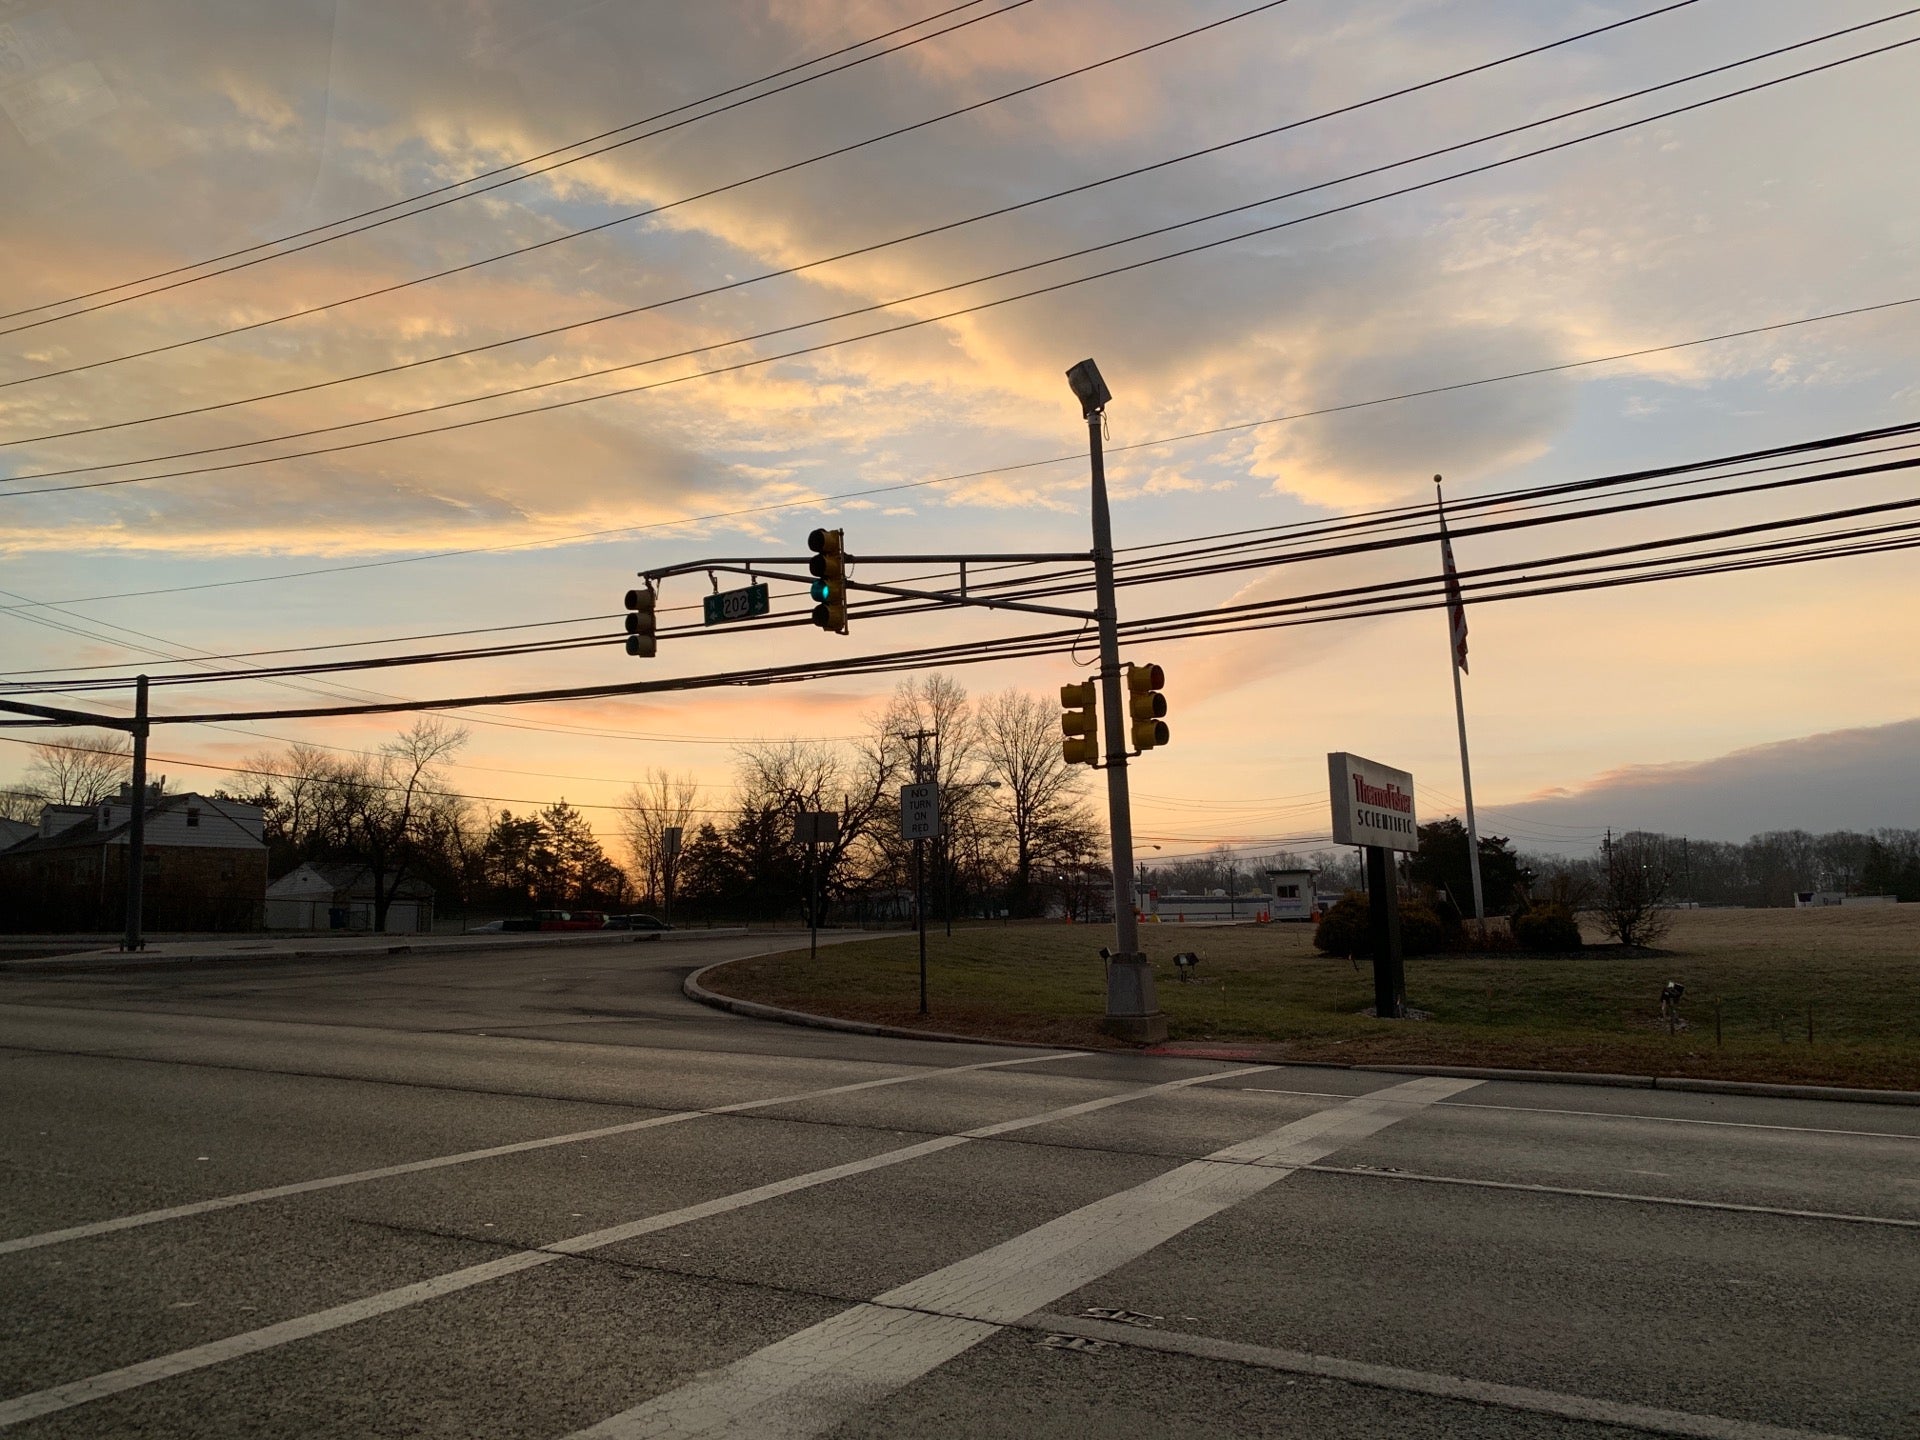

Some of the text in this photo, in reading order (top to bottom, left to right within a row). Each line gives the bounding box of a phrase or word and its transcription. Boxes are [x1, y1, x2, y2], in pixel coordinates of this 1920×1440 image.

[725, 595, 747, 614] 202
[911, 789, 928, 798] NO
[910, 800, 931, 810] TURN
[914, 811, 926, 820] ON
[1357, 809, 1412, 834] SCIENTIFIC
[912, 824, 928, 833] RED
